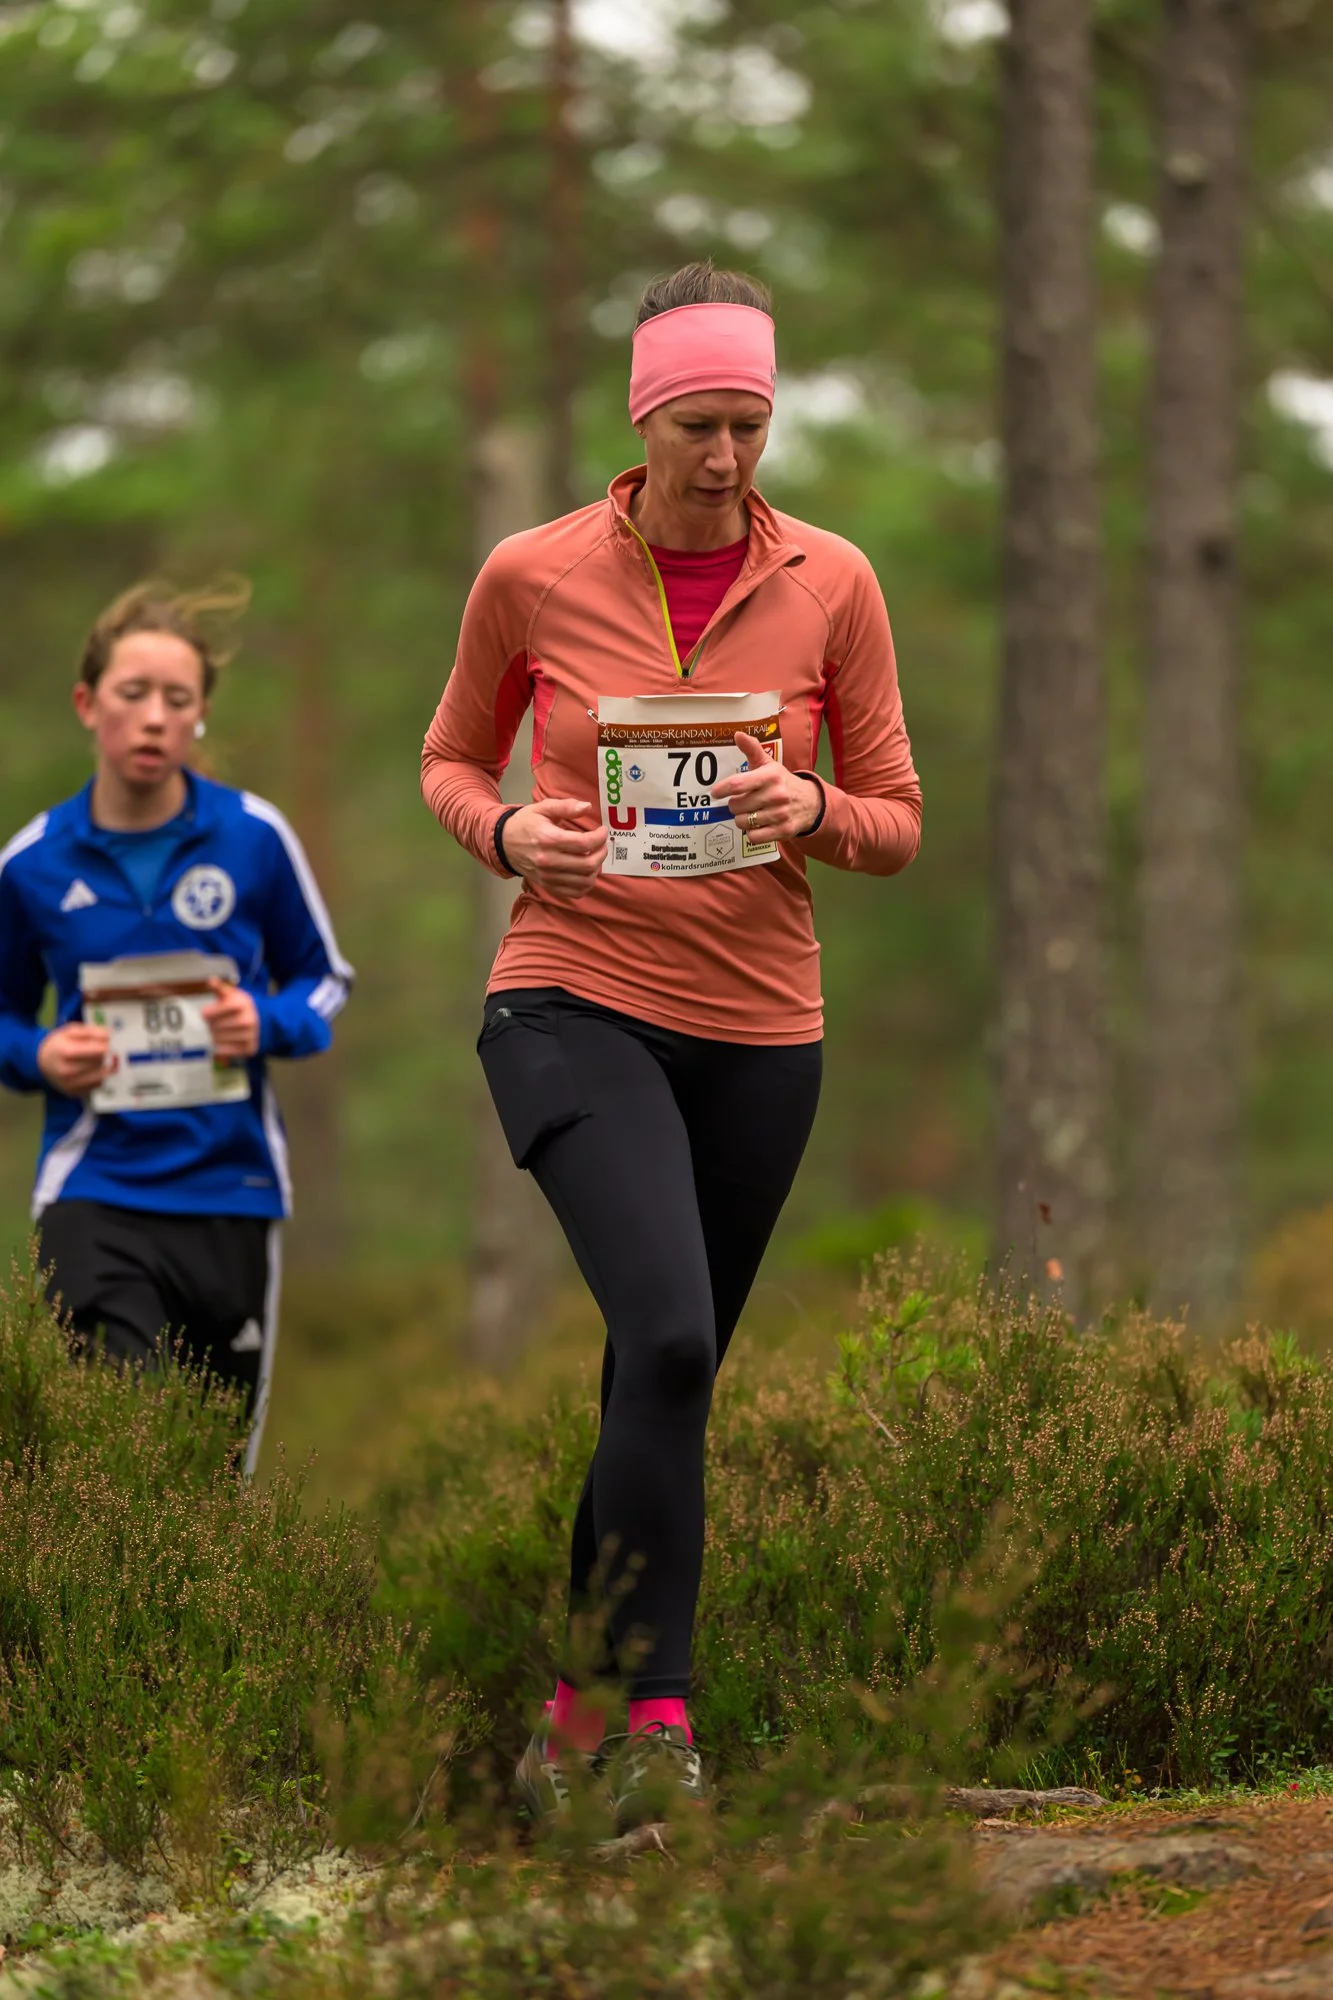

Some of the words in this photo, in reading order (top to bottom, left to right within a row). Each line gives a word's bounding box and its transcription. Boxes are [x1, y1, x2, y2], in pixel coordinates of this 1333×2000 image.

[667, 750, 718, 787] 70
[676, 792, 711, 808] Eva
[679, 812, 685, 822] 6
[661, 856, 736, 871] kolmardsrundantrail
